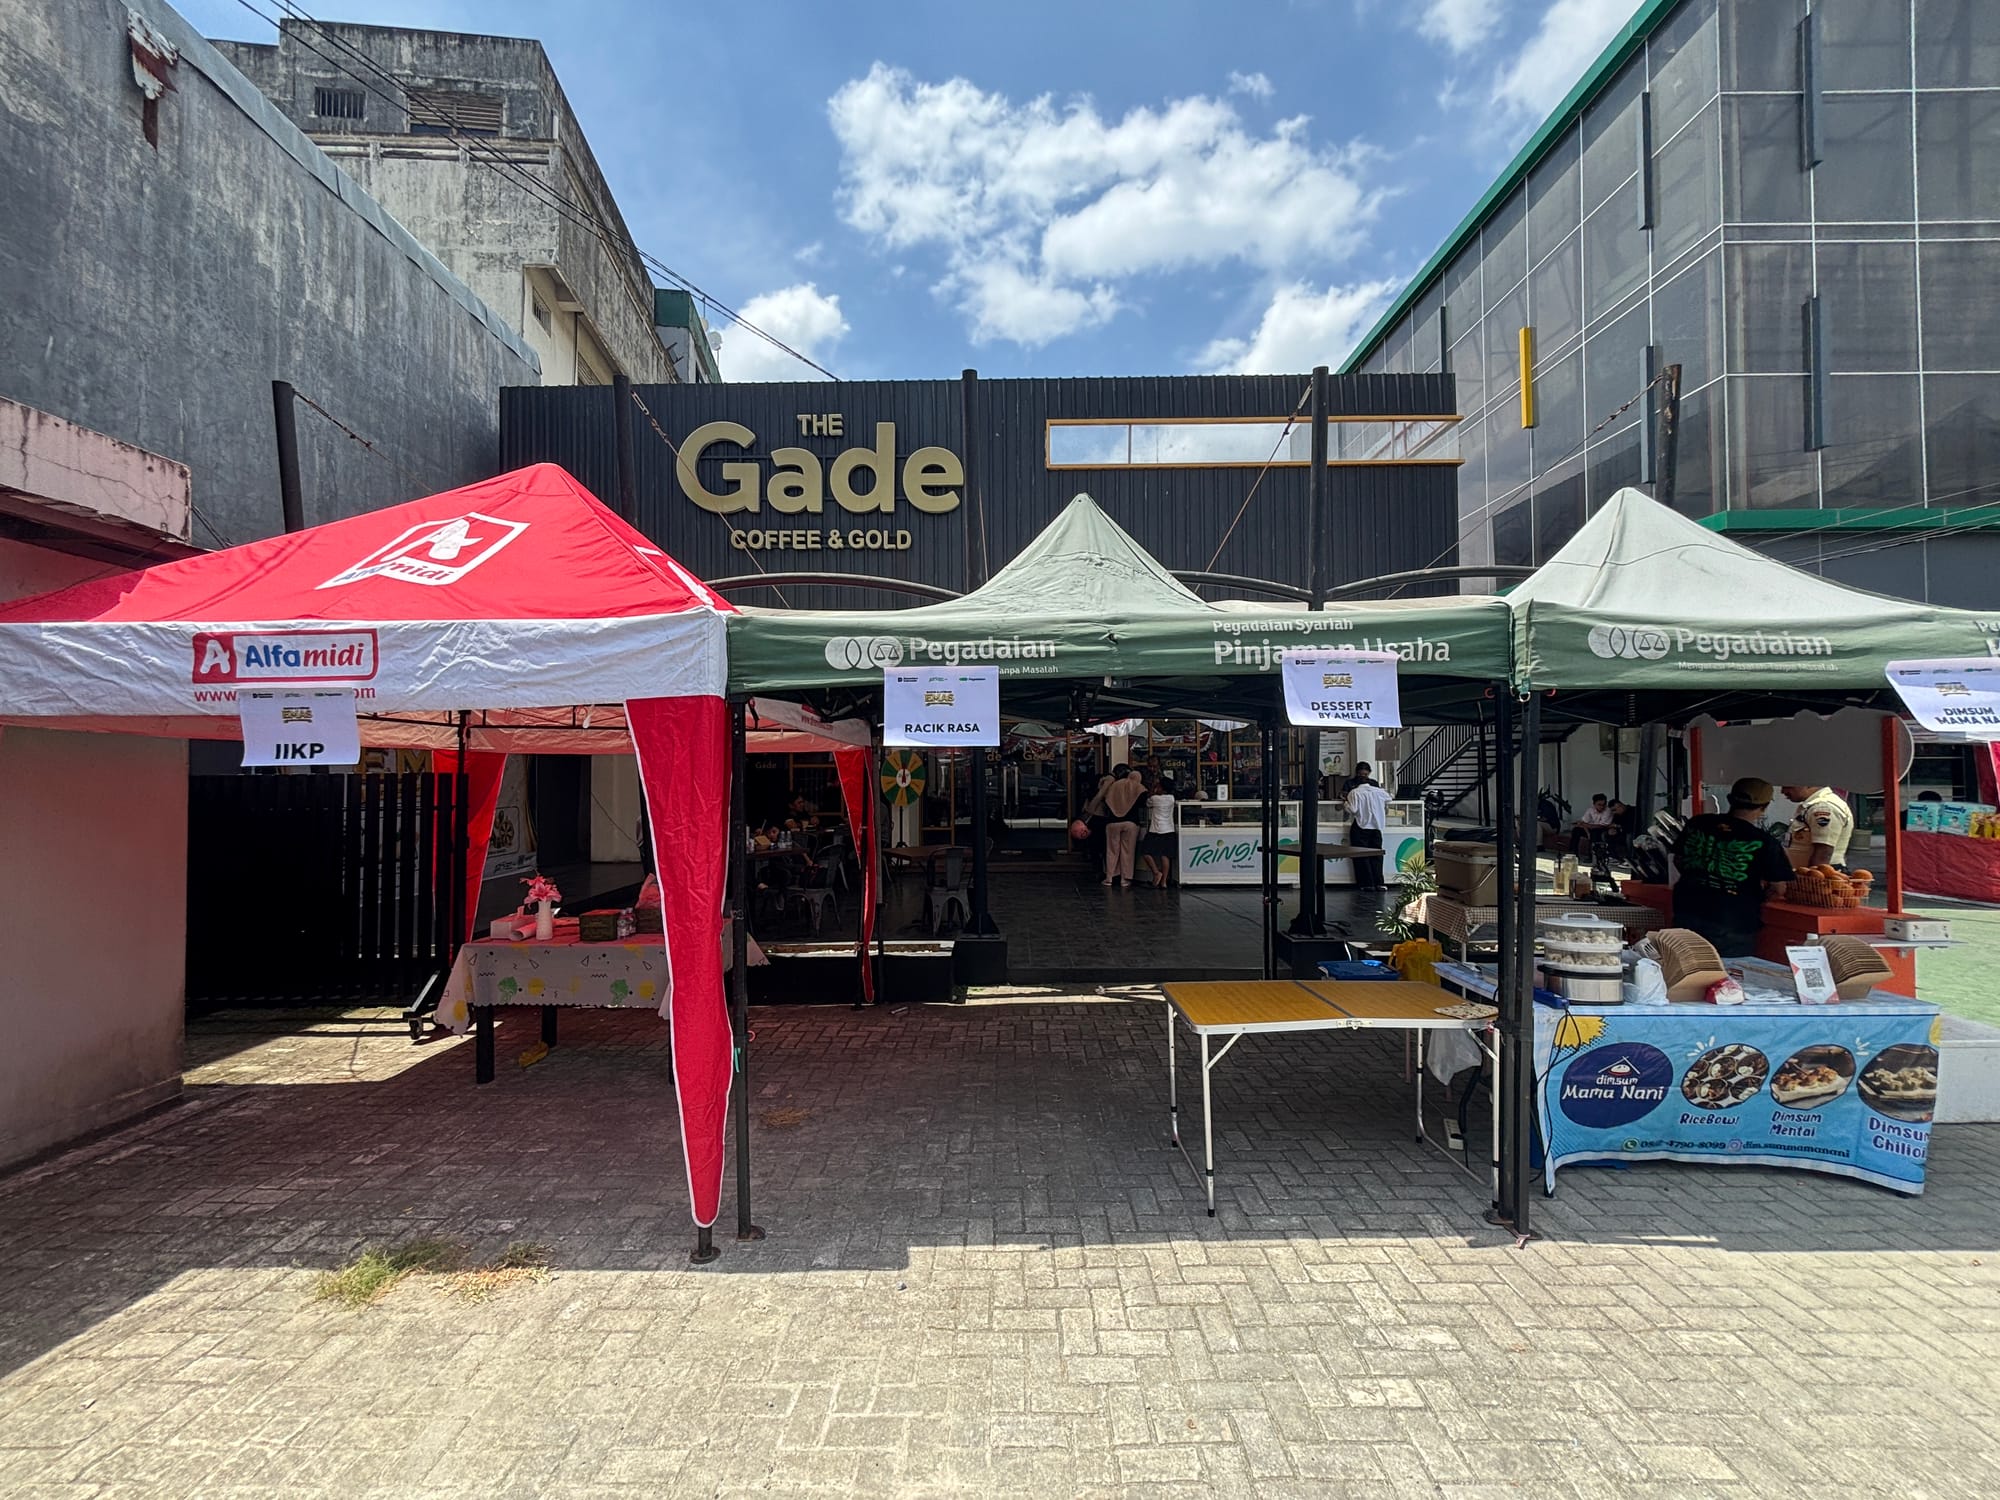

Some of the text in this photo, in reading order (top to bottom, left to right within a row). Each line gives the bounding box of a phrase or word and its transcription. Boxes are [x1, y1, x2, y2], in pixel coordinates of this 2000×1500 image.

[797, 414, 843, 437] THE
[676, 421, 964, 514] Gade
[731, 530, 911, 549] COFFEE & GOLD
[1213, 618, 1353, 635] Pegadaian Syariah
[909, 636, 1056, 666] Pegadaian
[1677, 628, 1832, 661] Pegadaian
[245, 642, 364, 668] Alfamidi
[1311, 701, 1372, 711] DESSERT
[1943, 707, 1995, 716] DIMSUM
[1334, 712, 1370, 720] AMELA
[1934, 716, 1979, 725] MAMA
[904, 723, 980, 733] RACIK RASA
[275, 743, 325, 760] IIKP
[1562, 1084, 1664, 1099] Mama Nani
[1771, 1110, 1822, 1122] Dimsum
